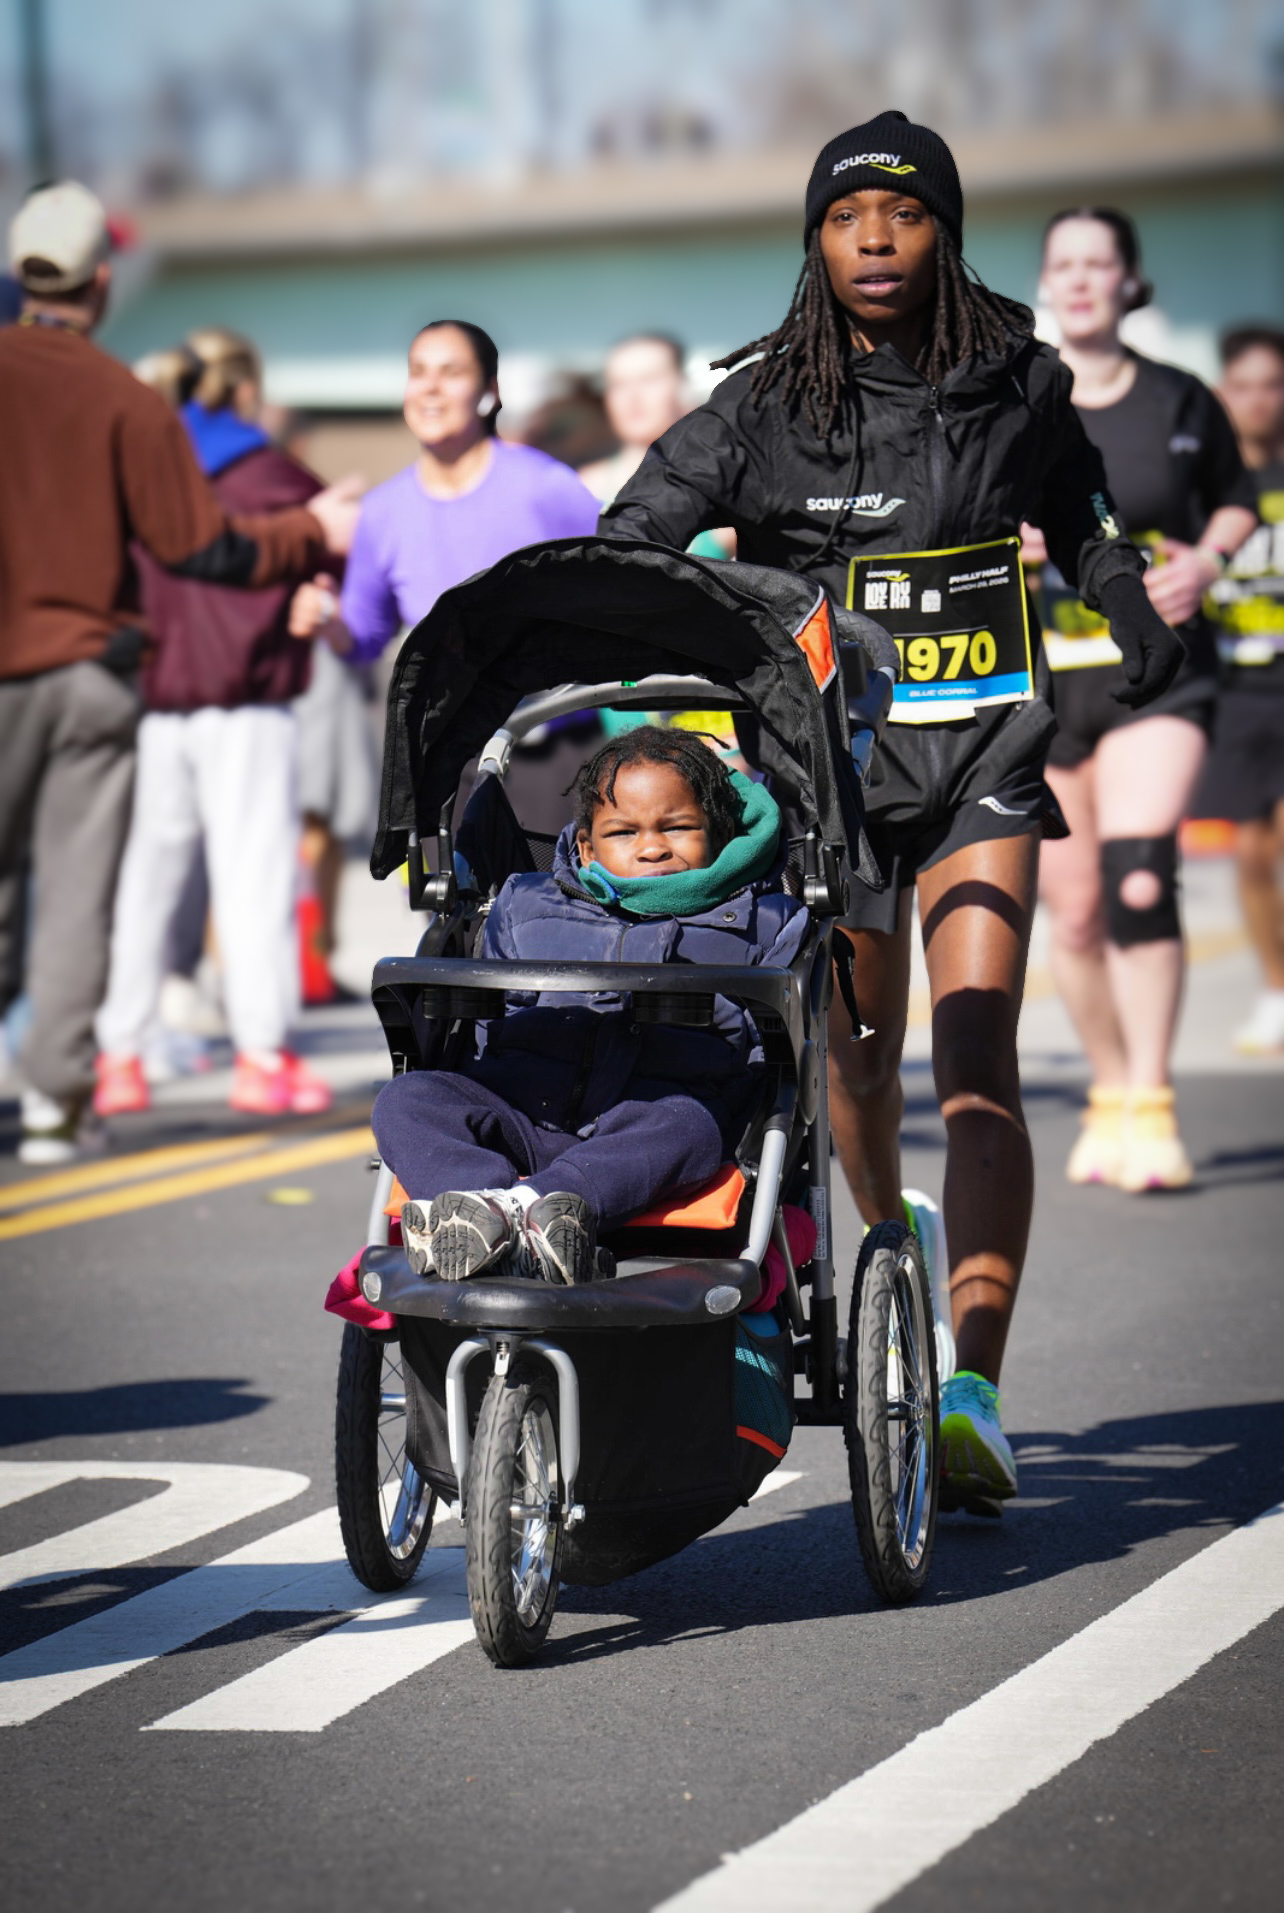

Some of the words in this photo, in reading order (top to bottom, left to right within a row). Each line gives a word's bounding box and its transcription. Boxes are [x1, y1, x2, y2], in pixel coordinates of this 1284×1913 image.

[832, 153, 901, 176] saucony
[948, 571, 982, 585] PHILLY
[981, 565, 1009, 578] HALF
[908, 689, 937, 698] BLUE
[937, 687, 978, 697] CORRAL
